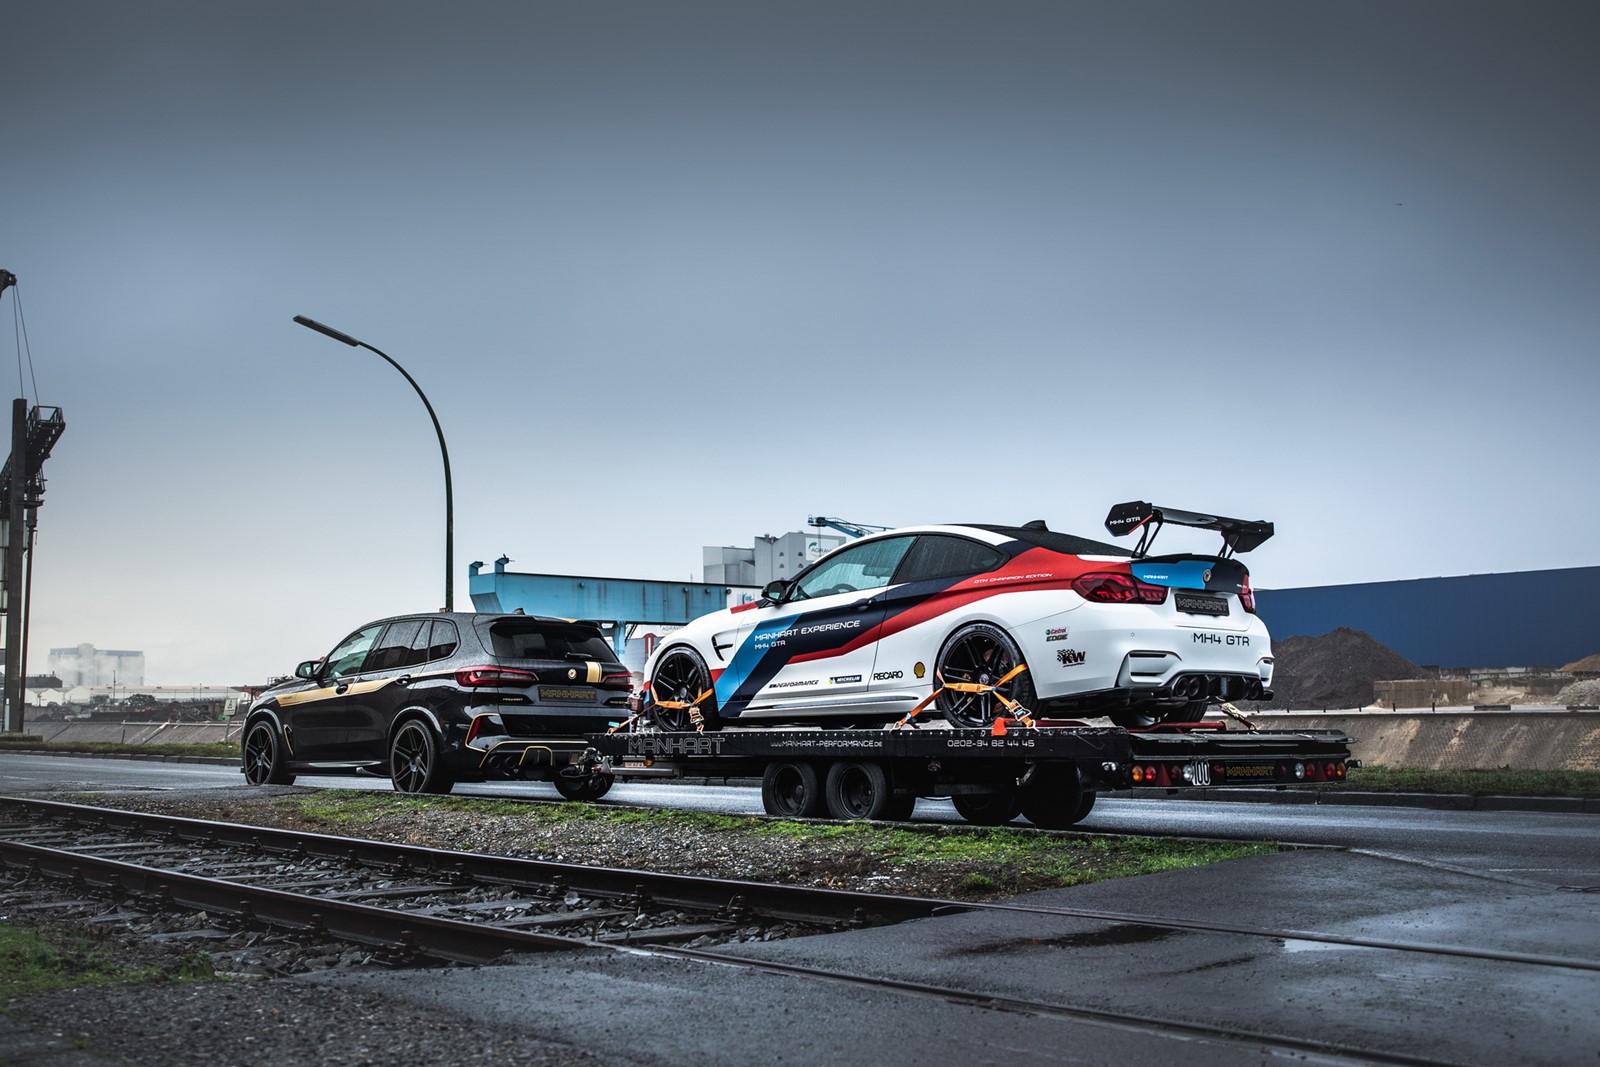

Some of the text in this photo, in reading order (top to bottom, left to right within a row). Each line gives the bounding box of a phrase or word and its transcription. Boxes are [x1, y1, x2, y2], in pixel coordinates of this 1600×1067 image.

[1176, 597, 1228, 612] MANHART
[754, 619, 861, 642] MANHART EXPERIENCE
[1050, 627, 1067, 635] Castrol
[770, 639, 786, 648] GTR
[1045, 633, 1068, 643] EDGE
[1193, 632, 1250, 647] MH4 GTR
[873, 670, 904, 681] RECARO
[540, 688, 596, 699] MANHART
[628, 737, 726, 755] MANHART
[947, 739, 1035, 748] 0202-94 62 44 45
[1226, 766, 1275, 777] MANHART
